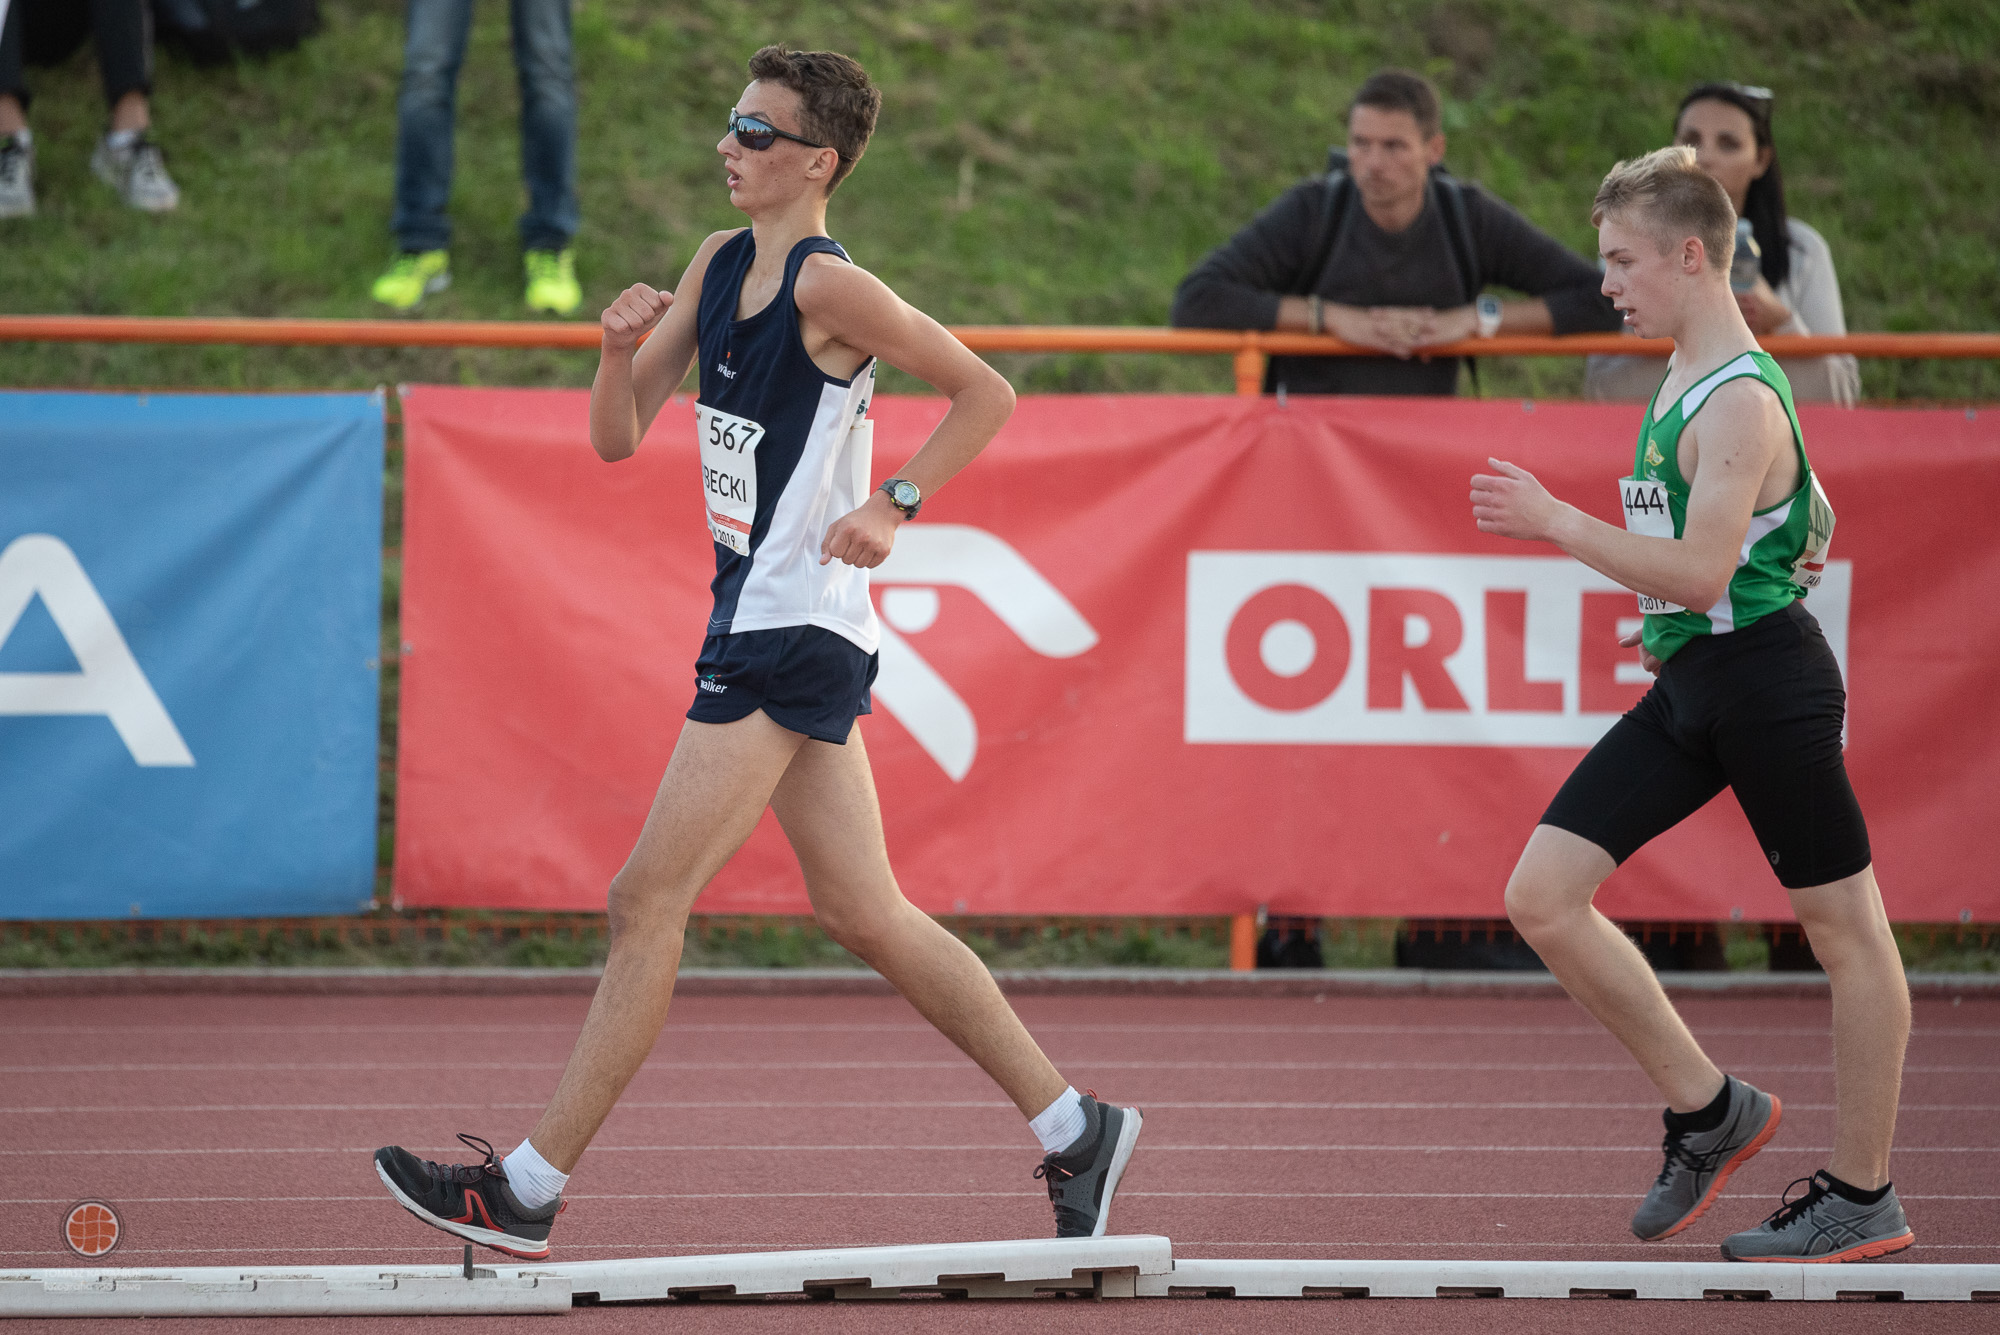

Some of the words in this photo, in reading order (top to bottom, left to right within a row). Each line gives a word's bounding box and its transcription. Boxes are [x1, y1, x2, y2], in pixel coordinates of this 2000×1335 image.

[709, 415, 758, 454] 567
[1625, 487, 1665, 515] 444
[718, 529, 736, 547] 2019
[1643, 597, 1667, 611] 2019
[0, 532, 197, 767] A
